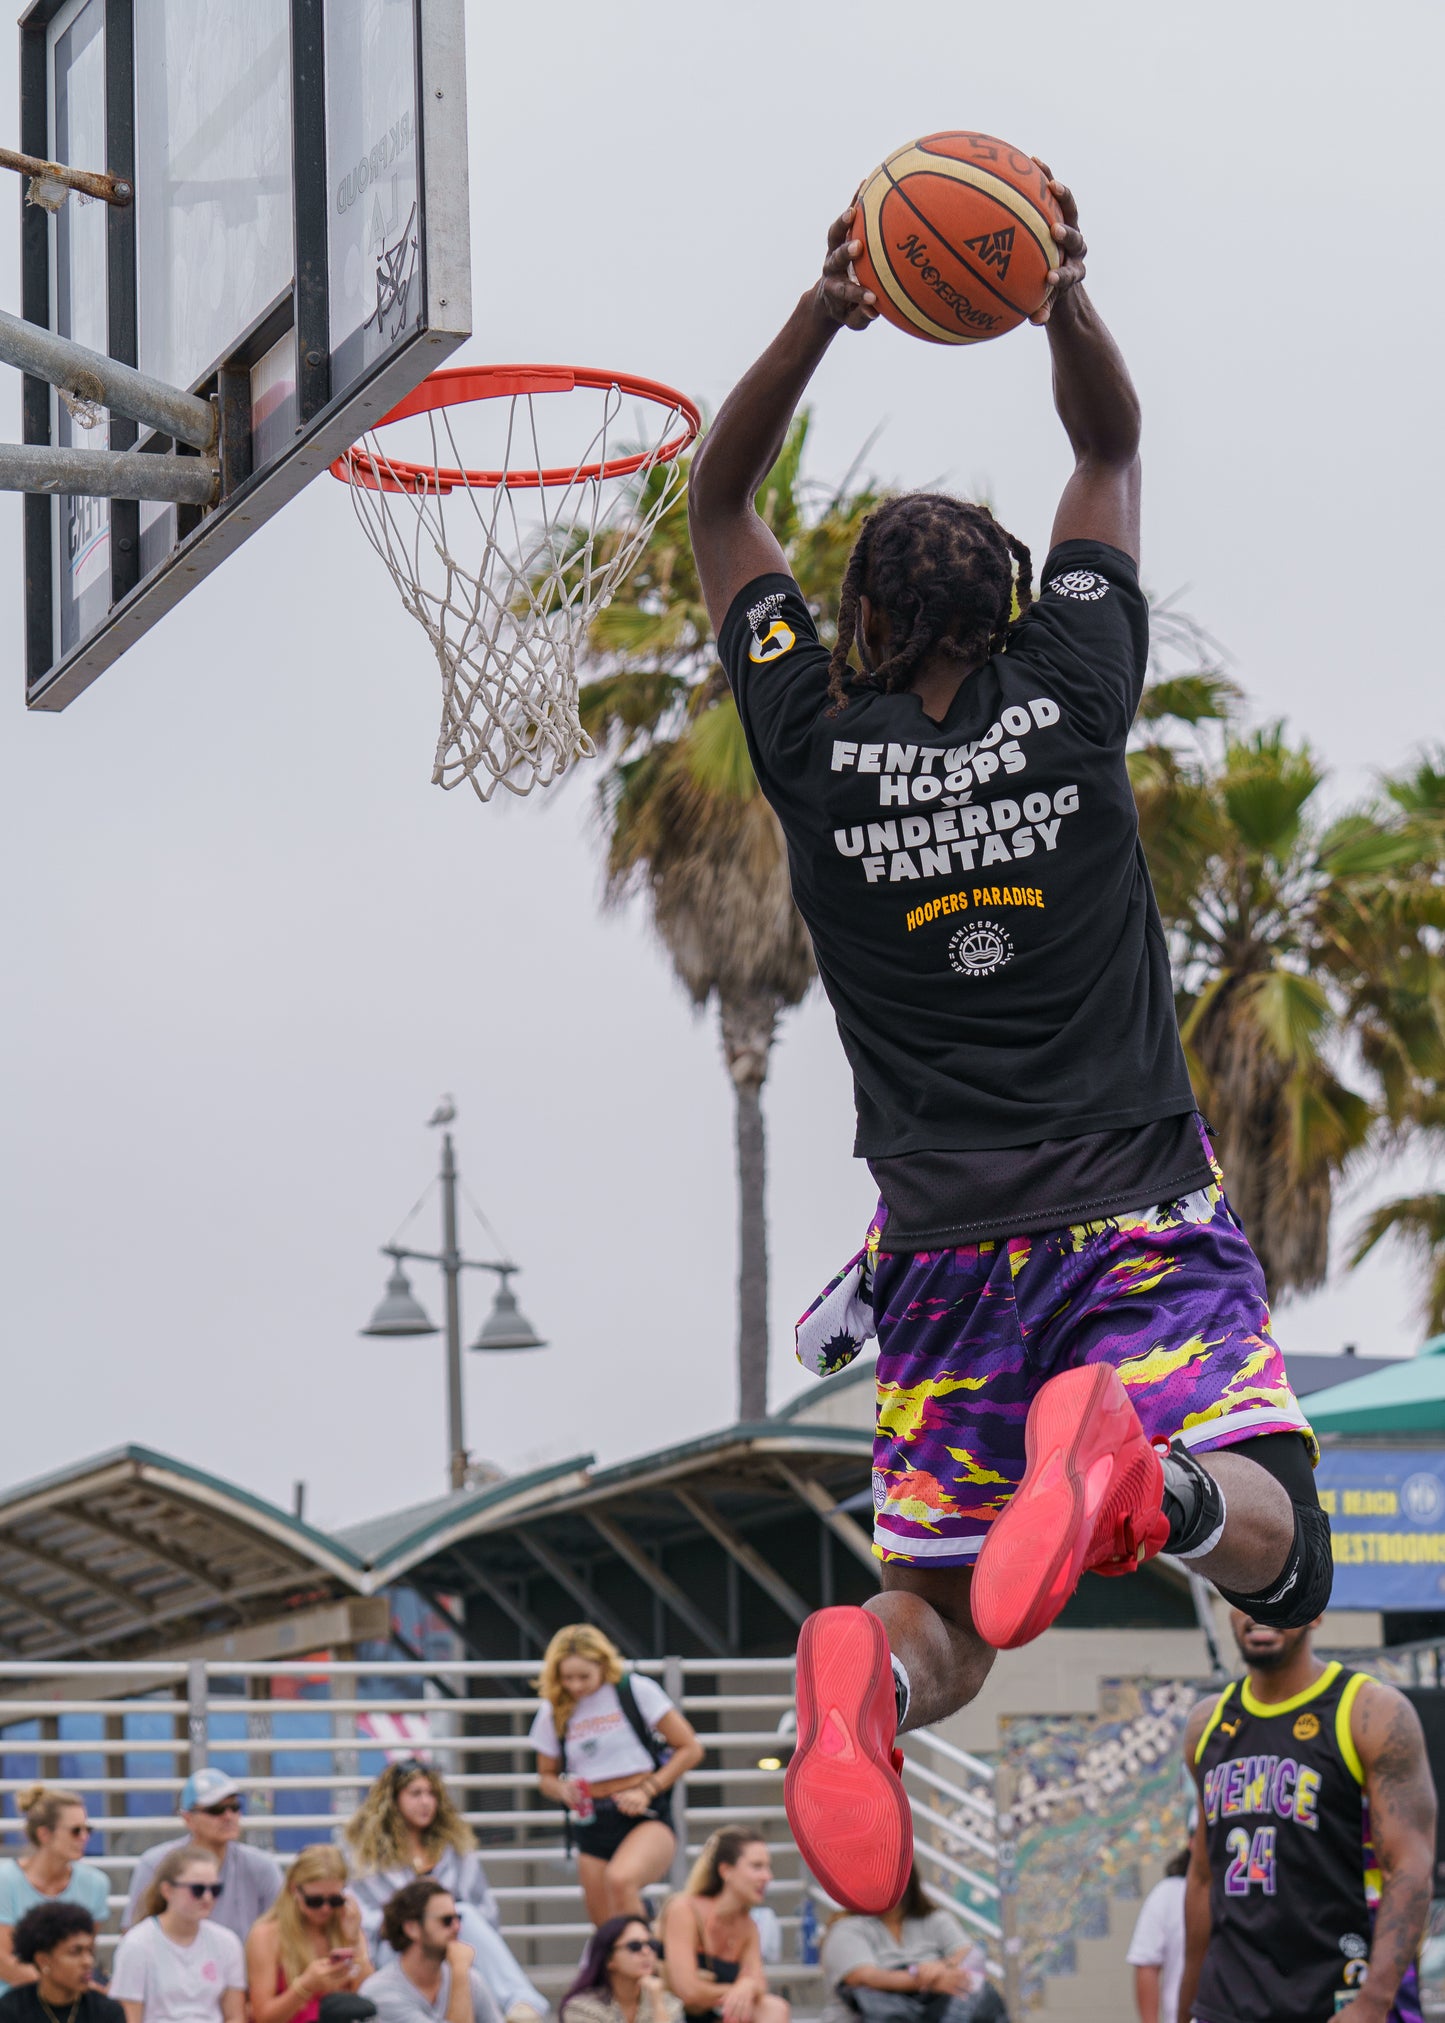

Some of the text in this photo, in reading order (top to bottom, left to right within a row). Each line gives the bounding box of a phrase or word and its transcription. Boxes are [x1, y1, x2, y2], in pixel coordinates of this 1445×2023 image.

[830, 697, 1061, 774] FENTWOOD
[879, 740, 1027, 806] HOOPS
[834, 784, 1080, 857] UNDERDOG
[861, 818, 1061, 883] FANTASY
[906, 886, 1045, 932] HOOPERS PARADISE
[948, 920, 1011, 950] VENICEBALL
[1203, 1754, 1322, 1832] VENICE
[1224, 1826, 1277, 1897] 24
